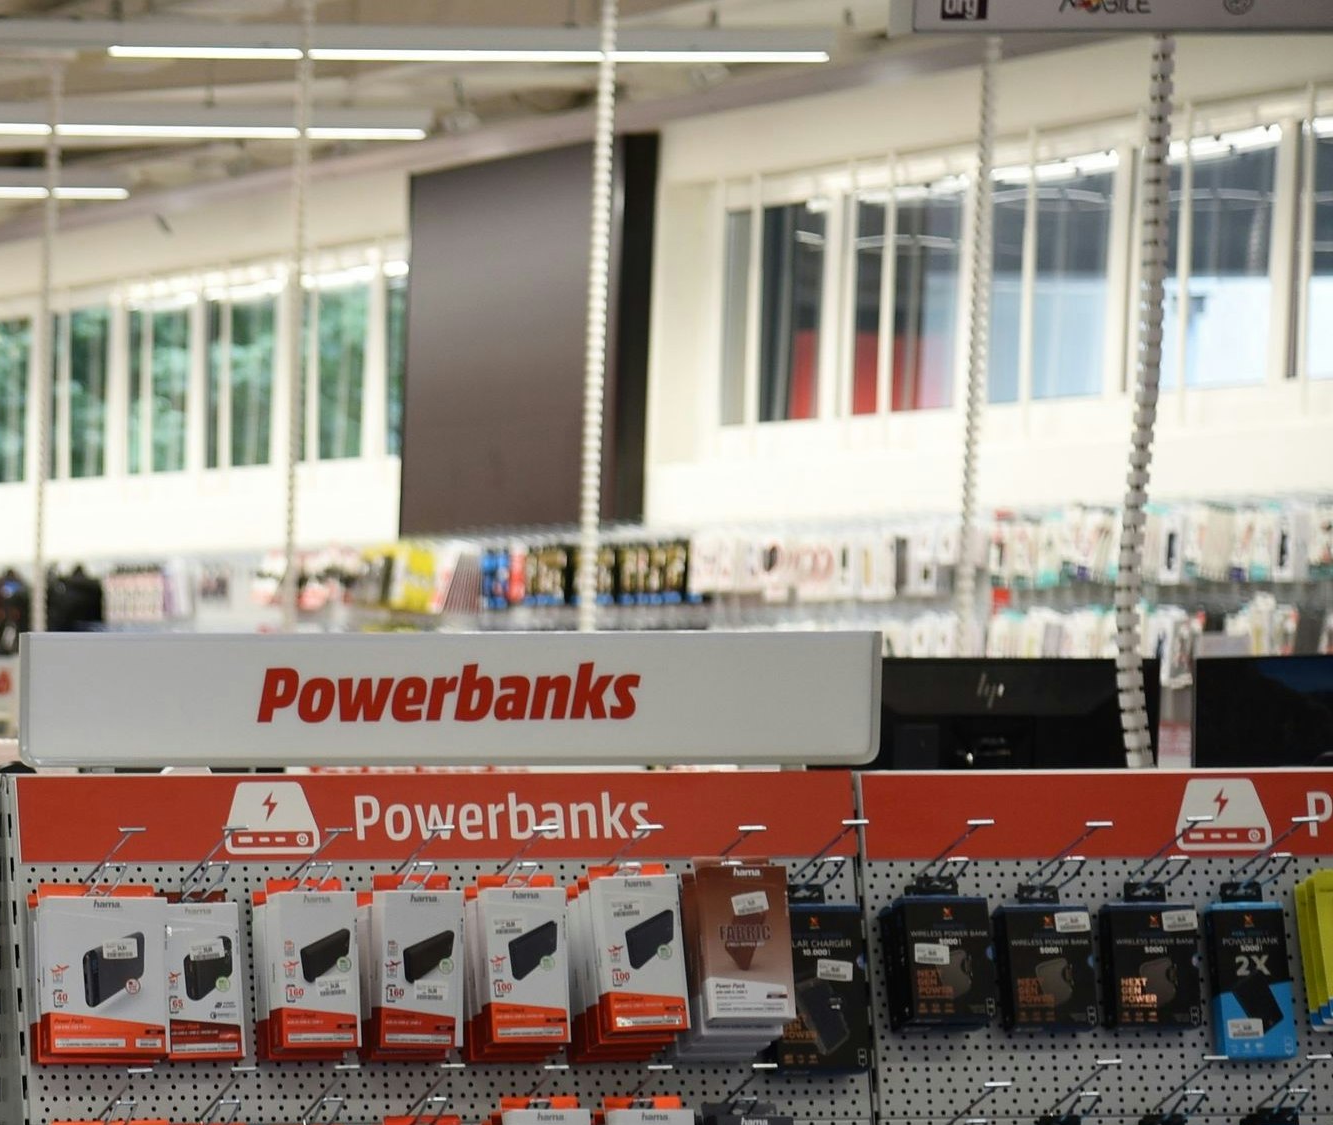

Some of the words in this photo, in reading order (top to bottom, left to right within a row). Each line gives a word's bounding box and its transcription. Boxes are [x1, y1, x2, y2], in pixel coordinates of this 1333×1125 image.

[257, 662, 642, 724] Powerbanks
[354, 791, 650, 841] Powerbanks
[1235, 955, 1271, 976] 2X
